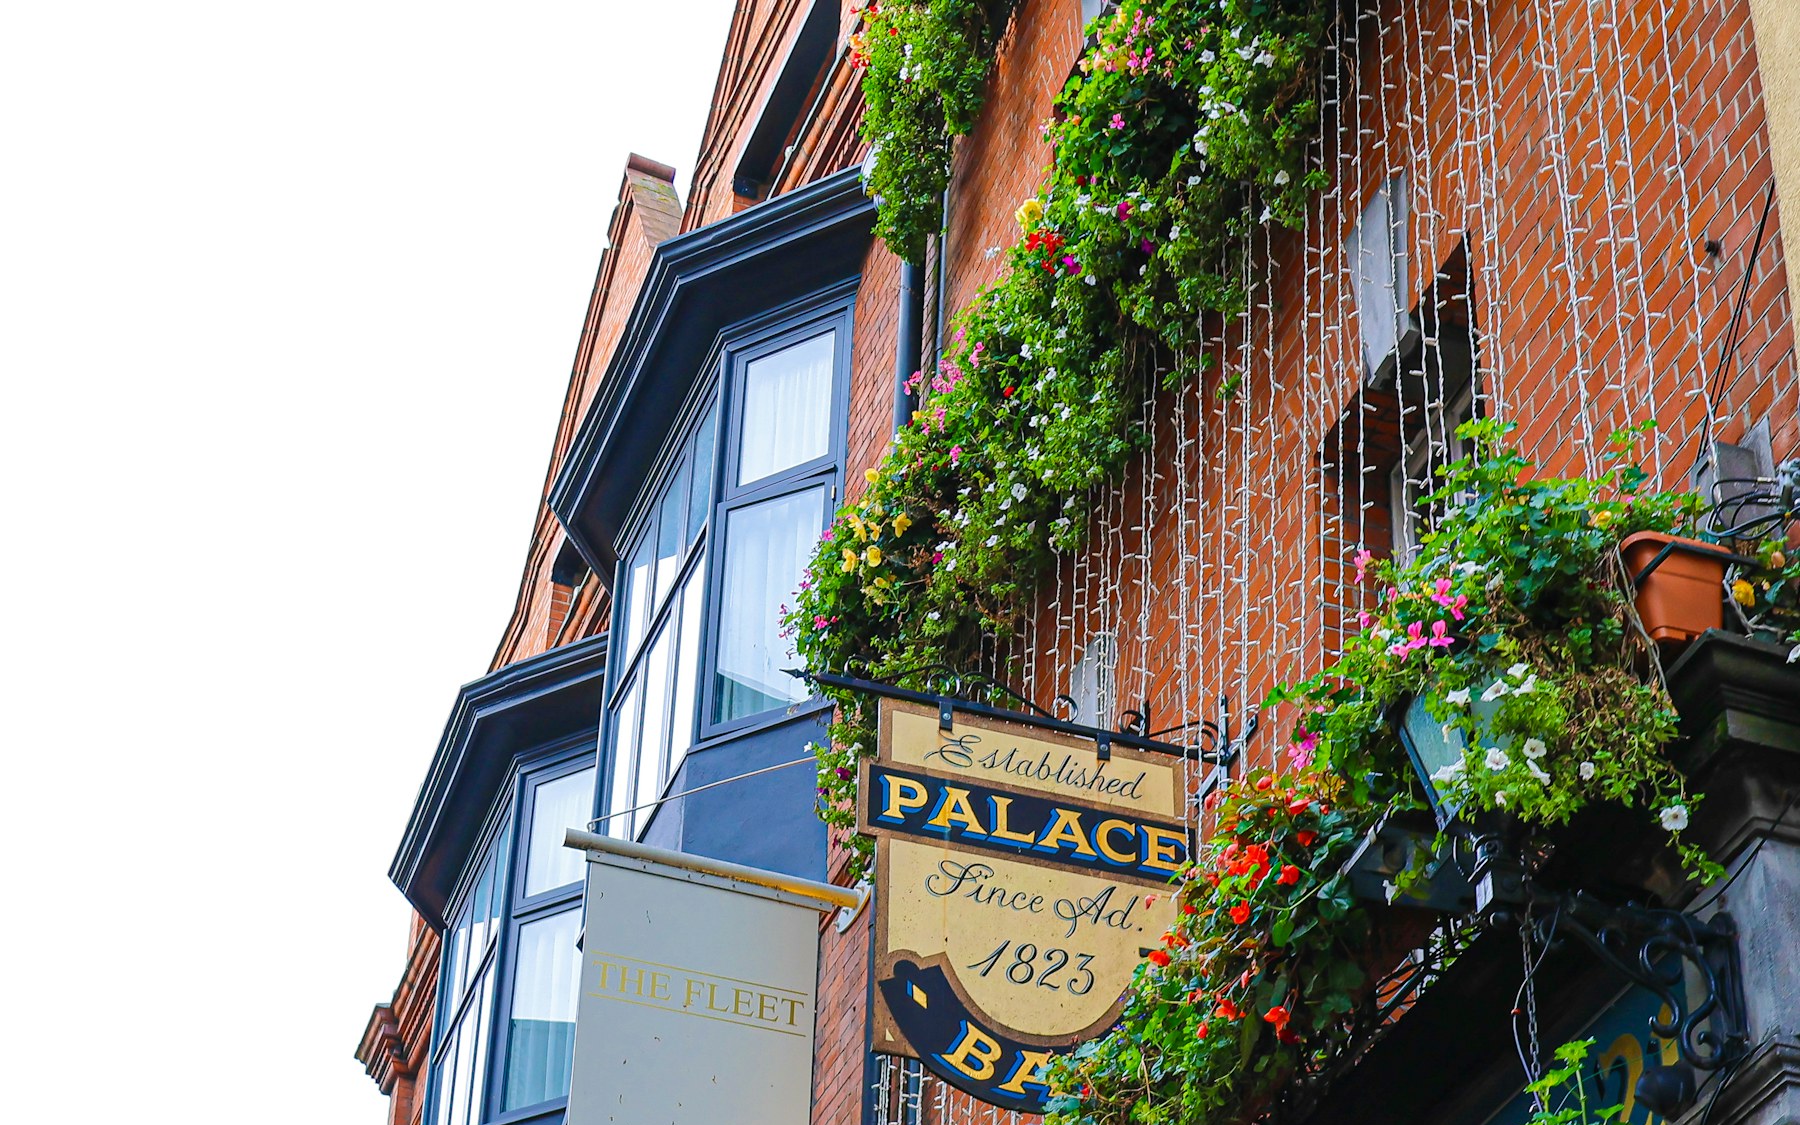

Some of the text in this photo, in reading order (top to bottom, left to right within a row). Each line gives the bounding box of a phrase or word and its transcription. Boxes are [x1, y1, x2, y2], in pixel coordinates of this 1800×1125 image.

[924, 729, 1147, 800] Established
[877, 774, 1187, 876] PALACE
[925, 860, 1044, 914] Since
[592, 960, 805, 1027] THE FLEET
[967, 939, 1096, 996] 1823
